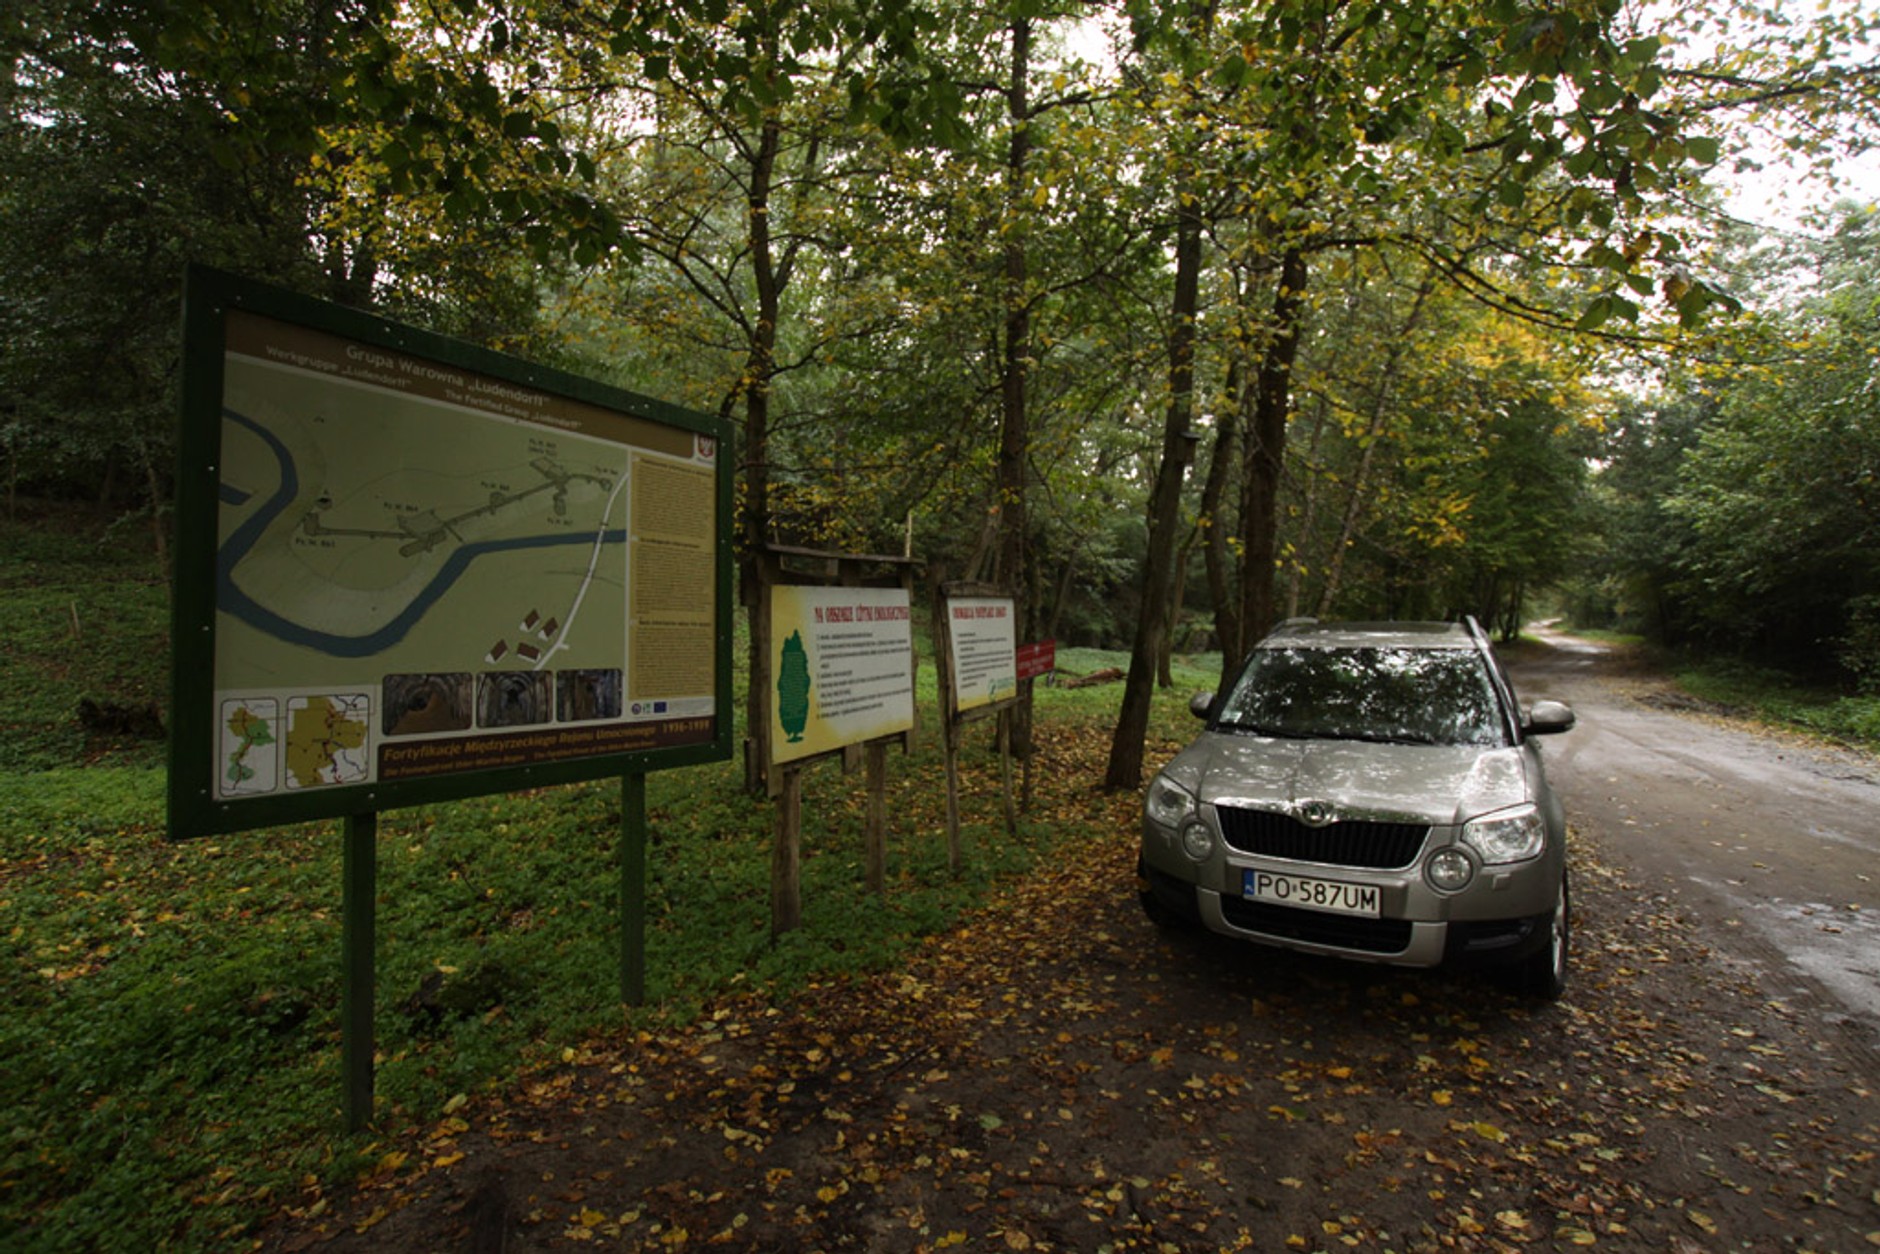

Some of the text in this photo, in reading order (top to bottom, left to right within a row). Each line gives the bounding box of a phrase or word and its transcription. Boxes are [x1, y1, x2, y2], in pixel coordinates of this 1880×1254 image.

[265, 344, 339, 371] Werkgruppe
[345, 344, 395, 369] Grupa
[398, 357, 464, 387] Warowna
[383, 744, 463, 762] Fortyfikacje
[1257, 874, 1376, 911] PO 587UM
